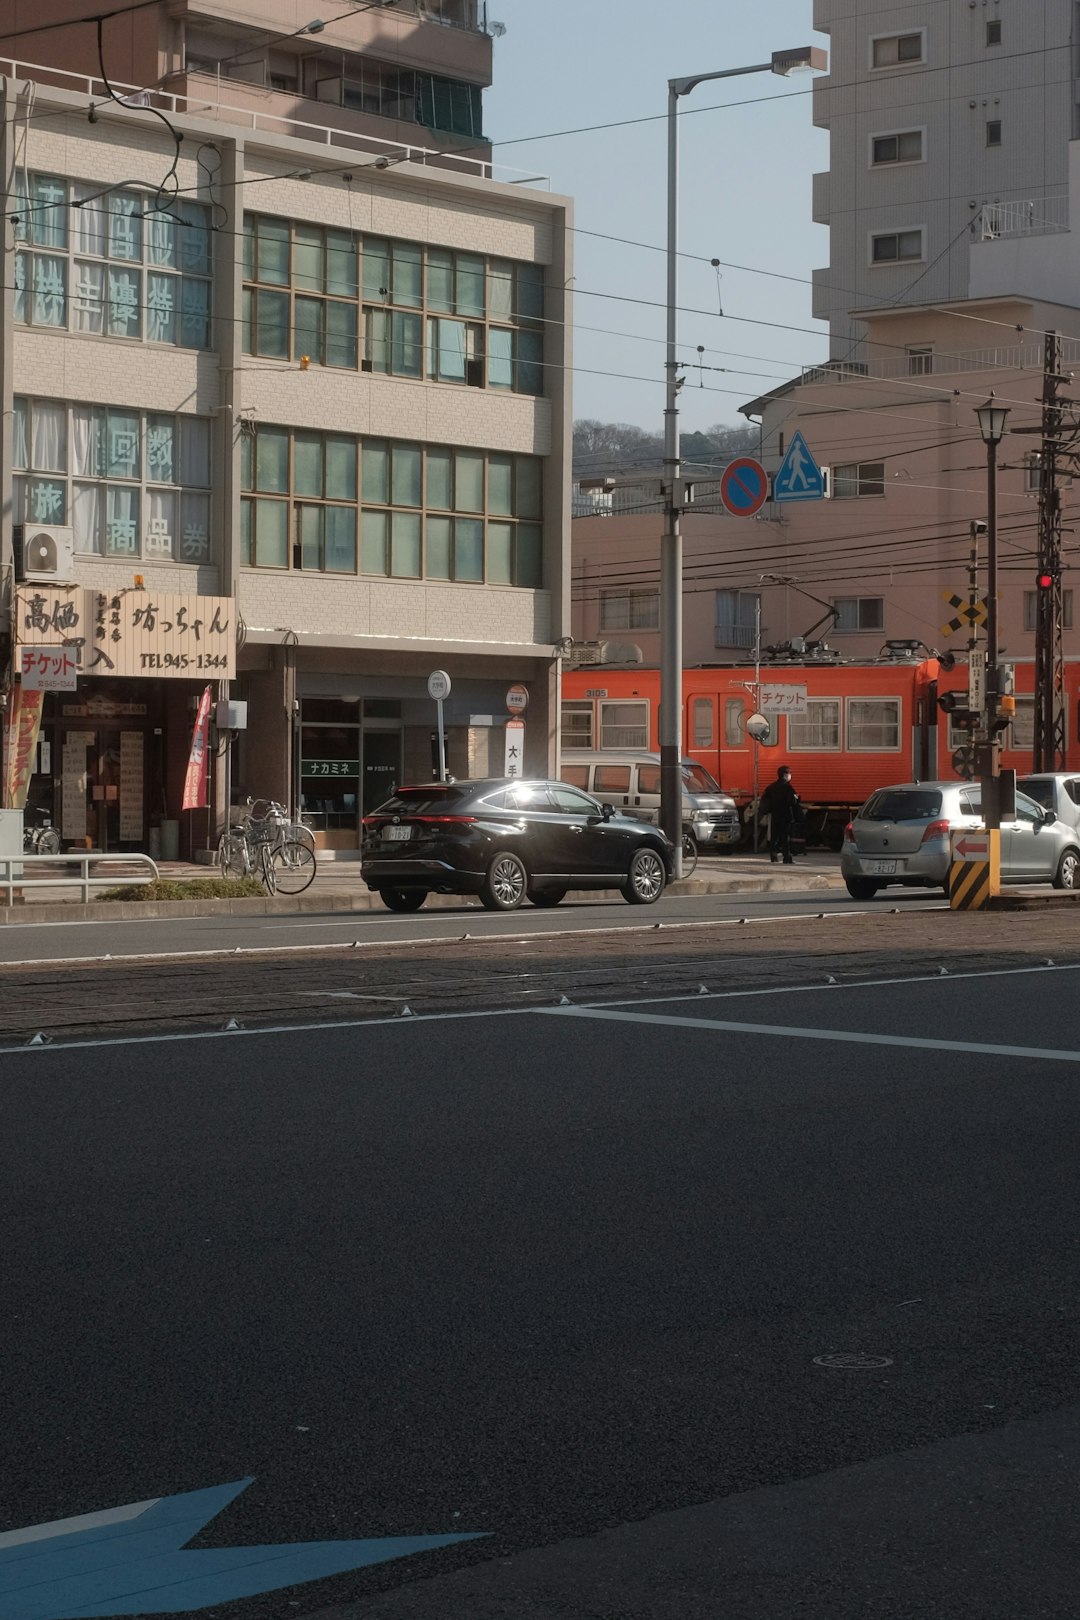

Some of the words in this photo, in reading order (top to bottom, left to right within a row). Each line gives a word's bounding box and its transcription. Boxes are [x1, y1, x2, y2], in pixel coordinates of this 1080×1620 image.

[109, 518, 209, 557] 商品券
[24, 593, 80, 634] 高価
[132, 602, 230, 641] 坊っちゃん
[22, 652, 76, 676] チケット
[586, 689, 607, 697] 3105
[761, 692, 806, 705] チケット
[310, 762, 350, 774] ナカミネ
